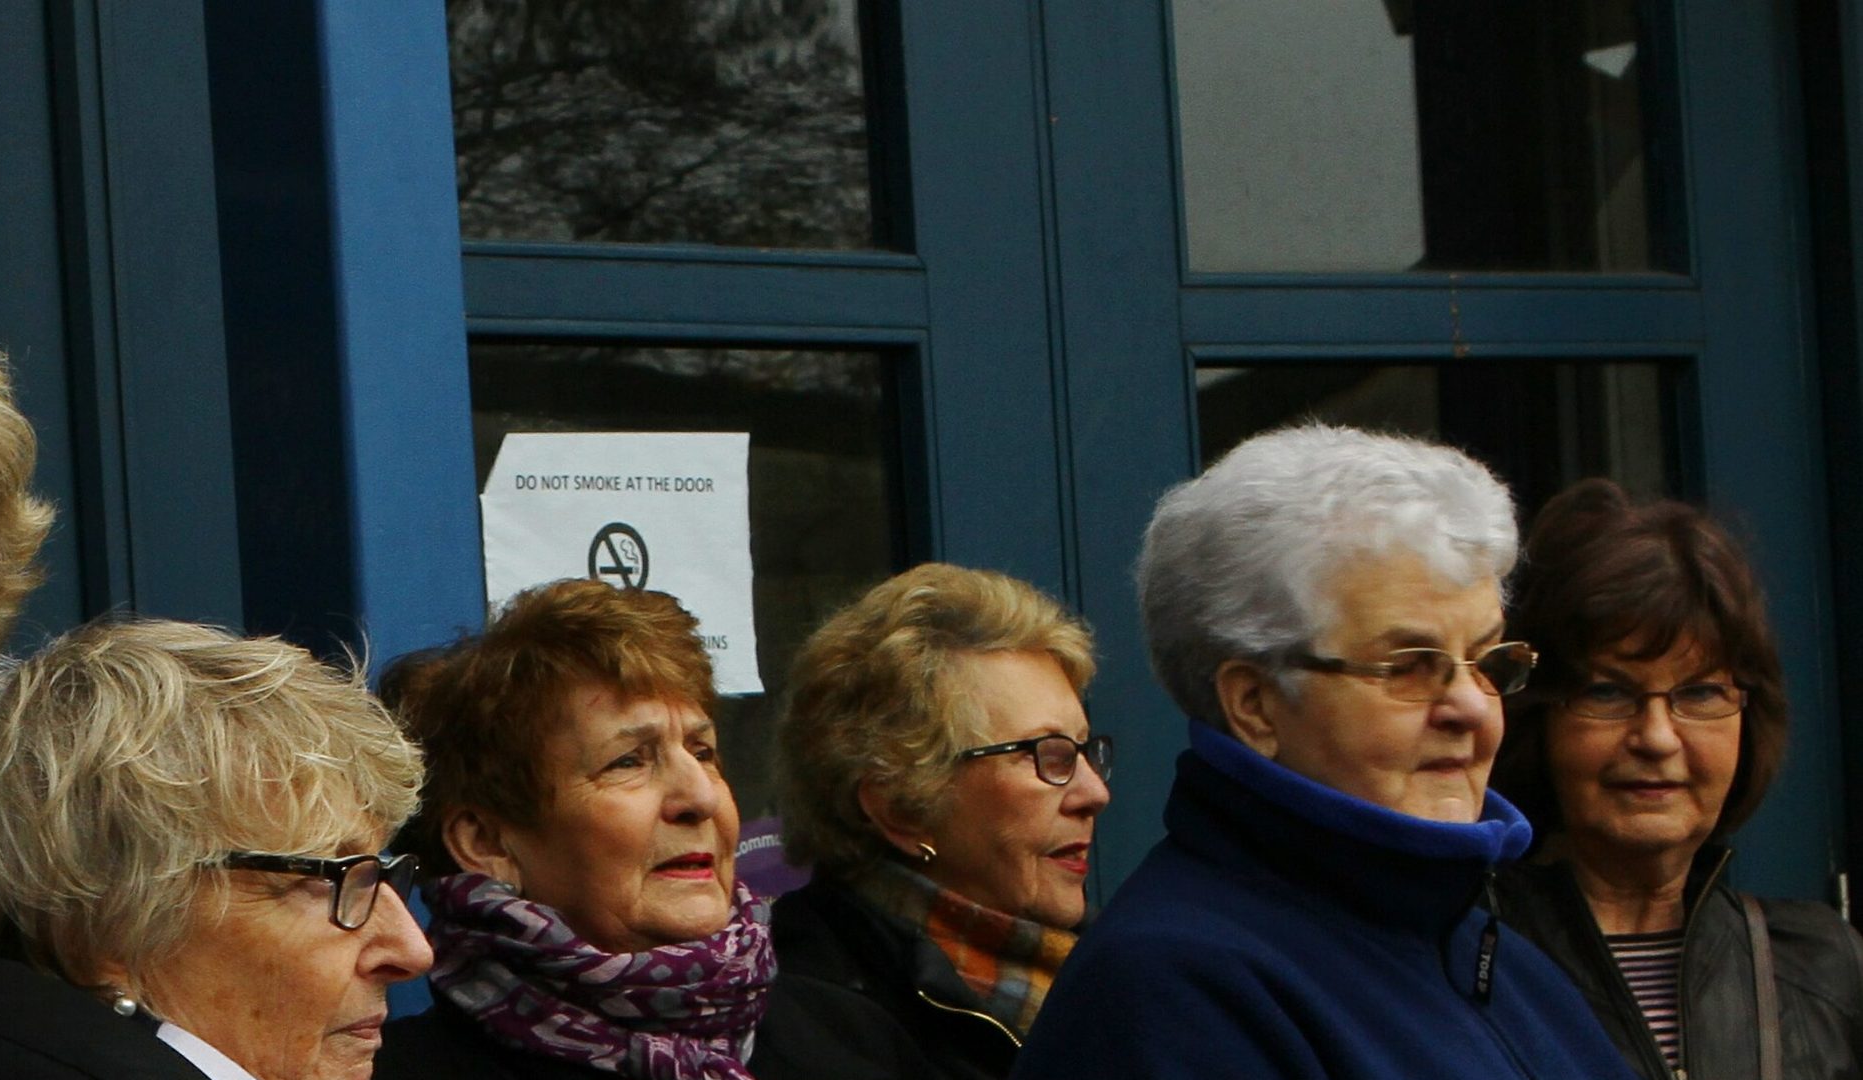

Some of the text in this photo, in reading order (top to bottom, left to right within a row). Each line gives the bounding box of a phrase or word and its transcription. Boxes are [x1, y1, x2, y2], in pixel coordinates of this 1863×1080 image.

[515, 474, 714, 493] DO NOT SMOKE AT THE DOOR
